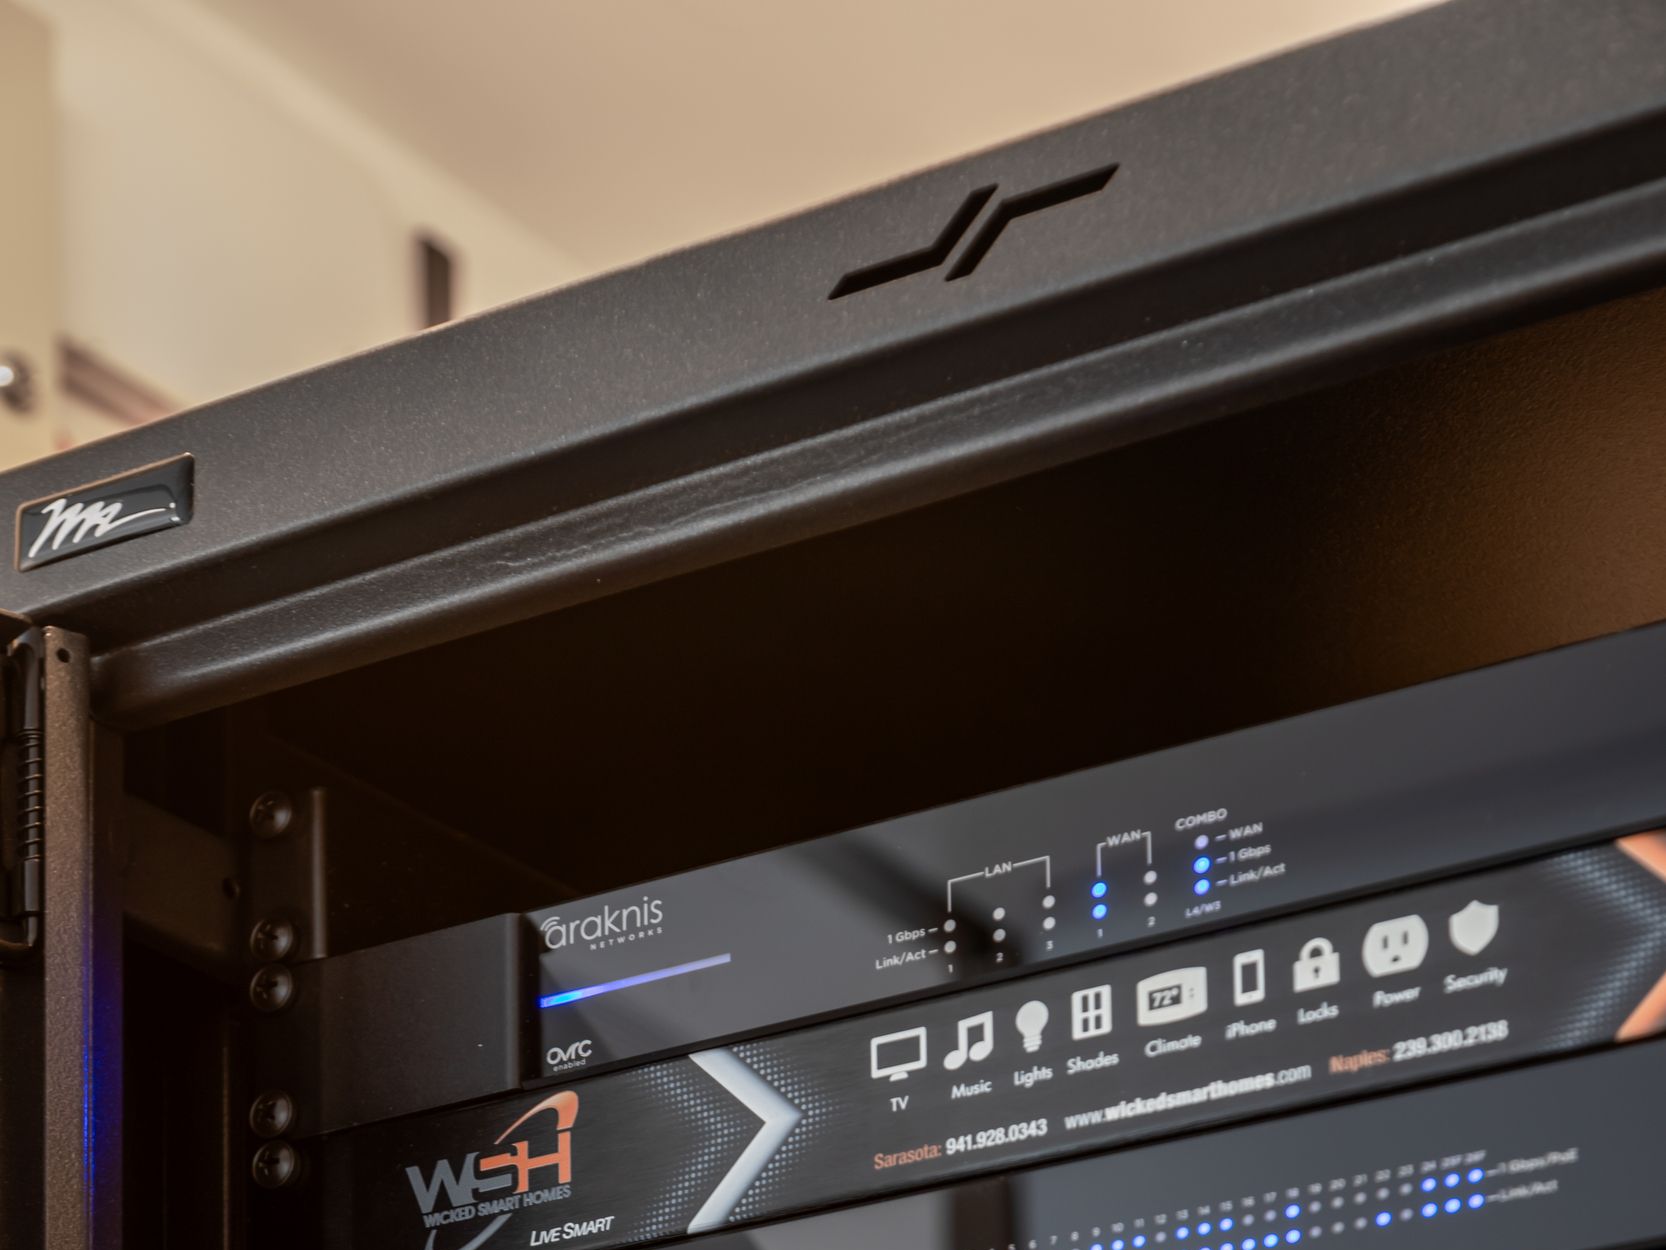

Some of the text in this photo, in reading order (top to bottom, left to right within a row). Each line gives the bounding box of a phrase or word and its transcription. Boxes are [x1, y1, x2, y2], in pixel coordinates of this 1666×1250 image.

[1175, 808, 1228, 831] COMBO
[1107, 829, 1142, 848] WAN
[1228, 822, 1263, 840] WAN
[1237, 844, 1272, 861] Gbps
[984, 862, 1012, 878] LAN
[1229, 862, 1286, 887] Link/Act
[540, 896, 663, 950] araknis
[1147, 916, 1156, 927] 2
[590, 926, 663, 950] NETWORKS
[895, 926, 926, 943] Gbps
[875, 947, 926, 970] Link/Act
[996, 952, 1003, 962] 2
[1046, 940, 1053, 950] 3
[889, 966, 1508, 1112] TV Music Lights Shades Climate iPhone Locks Power Security
[553, 1058, 586, 1072] enabled
[874, 1143, 941, 1170] Sarasota:
[946, 1118, 1048, 1155] 941.928.0343
[1064, 1065, 1312, 1129] www.wickedsmarthomes.com
[1329, 1048, 1390, 1074] Naples:
[423, 1184, 572, 1228] WICKED SMART HOMES
[530, 1216, 615, 1246] LIVE SMART
[1029, 1240, 1037, 1249] 6
[1050, 1235, 1058, 1245] 7
